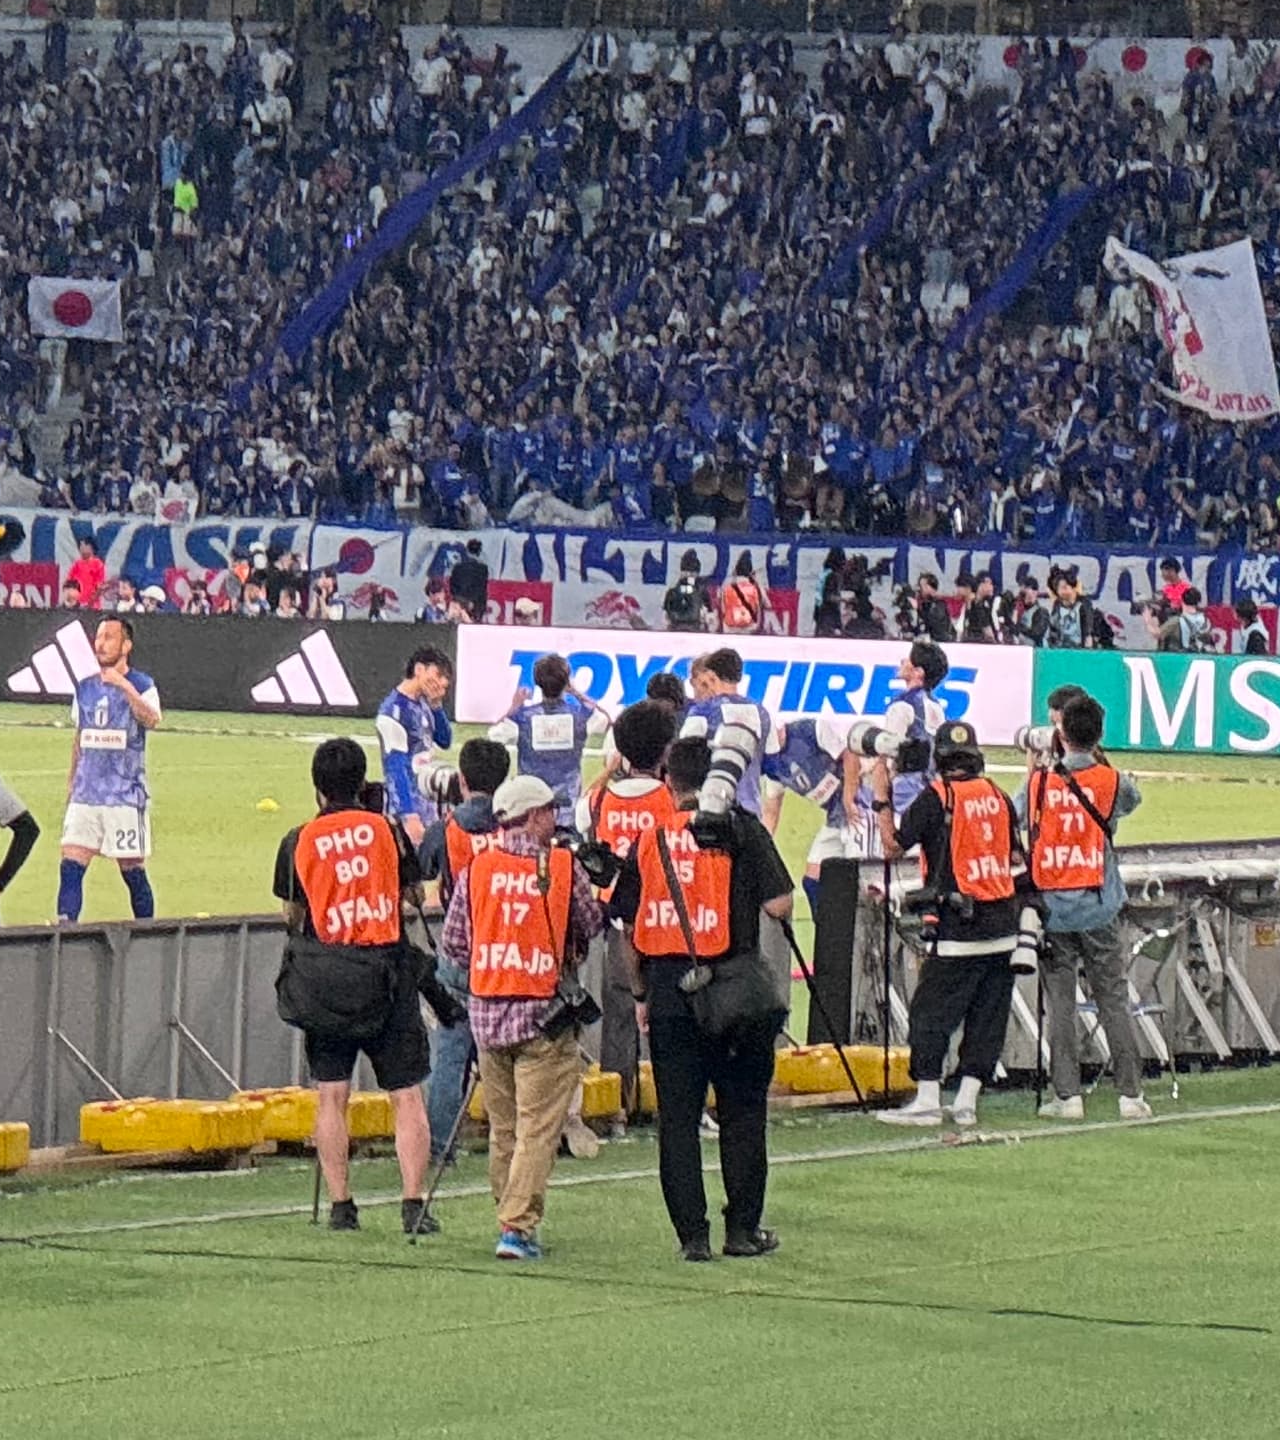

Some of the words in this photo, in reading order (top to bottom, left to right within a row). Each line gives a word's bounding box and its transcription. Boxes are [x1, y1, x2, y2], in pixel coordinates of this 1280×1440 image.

[964, 795, 1000, 820] PHO
[607, 811, 655, 831] PHO
[1059, 812, 1085, 833] 71
[116, 829, 137, 850] 22
[314, 824, 374, 860] PHO
[471, 830, 504, 856] PH
[335, 855, 369, 884] 80
[491, 872, 543, 897] PHO
[501, 902, 531, 926] 17
